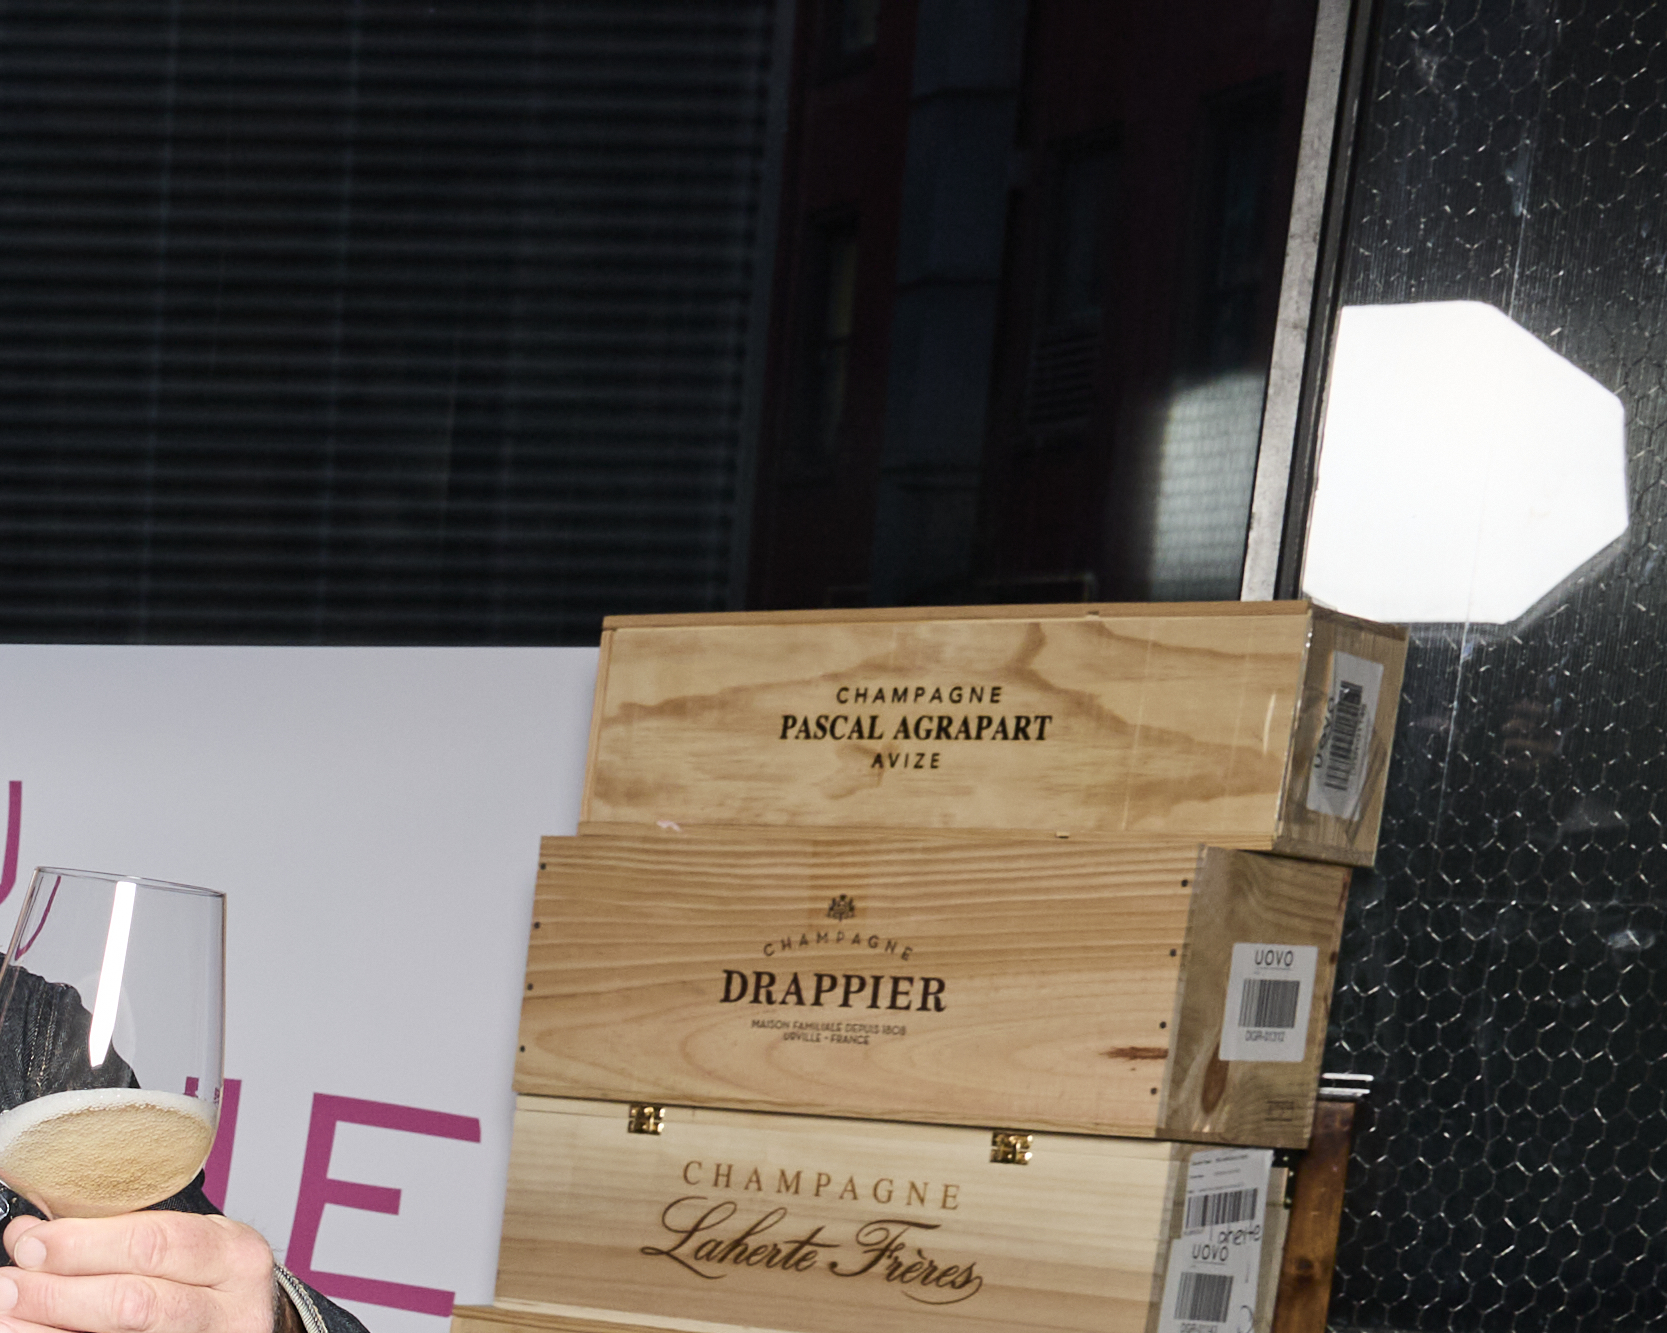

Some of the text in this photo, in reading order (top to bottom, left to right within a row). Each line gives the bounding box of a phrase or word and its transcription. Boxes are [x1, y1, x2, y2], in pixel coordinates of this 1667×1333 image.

[836, 686, 1003, 704] CHAMPAGNE
[779, 714, 1053, 741] PASCAL AGRAPART
[871, 752, 941, 769] AVIZE
[763, 931, 914, 962] CHAMPAGNE
[1254, 949, 1294, 967] UOVO
[719, 968, 948, 1013] DRAPPIER
[830, 1034, 871, 1046] FRANCE
[683, 1160, 960, 1211] CHAMPAGNE
[640, 1195, 983, 1306] Laherte Frères
[1192, 1243, 1229, 1262] UOVO
